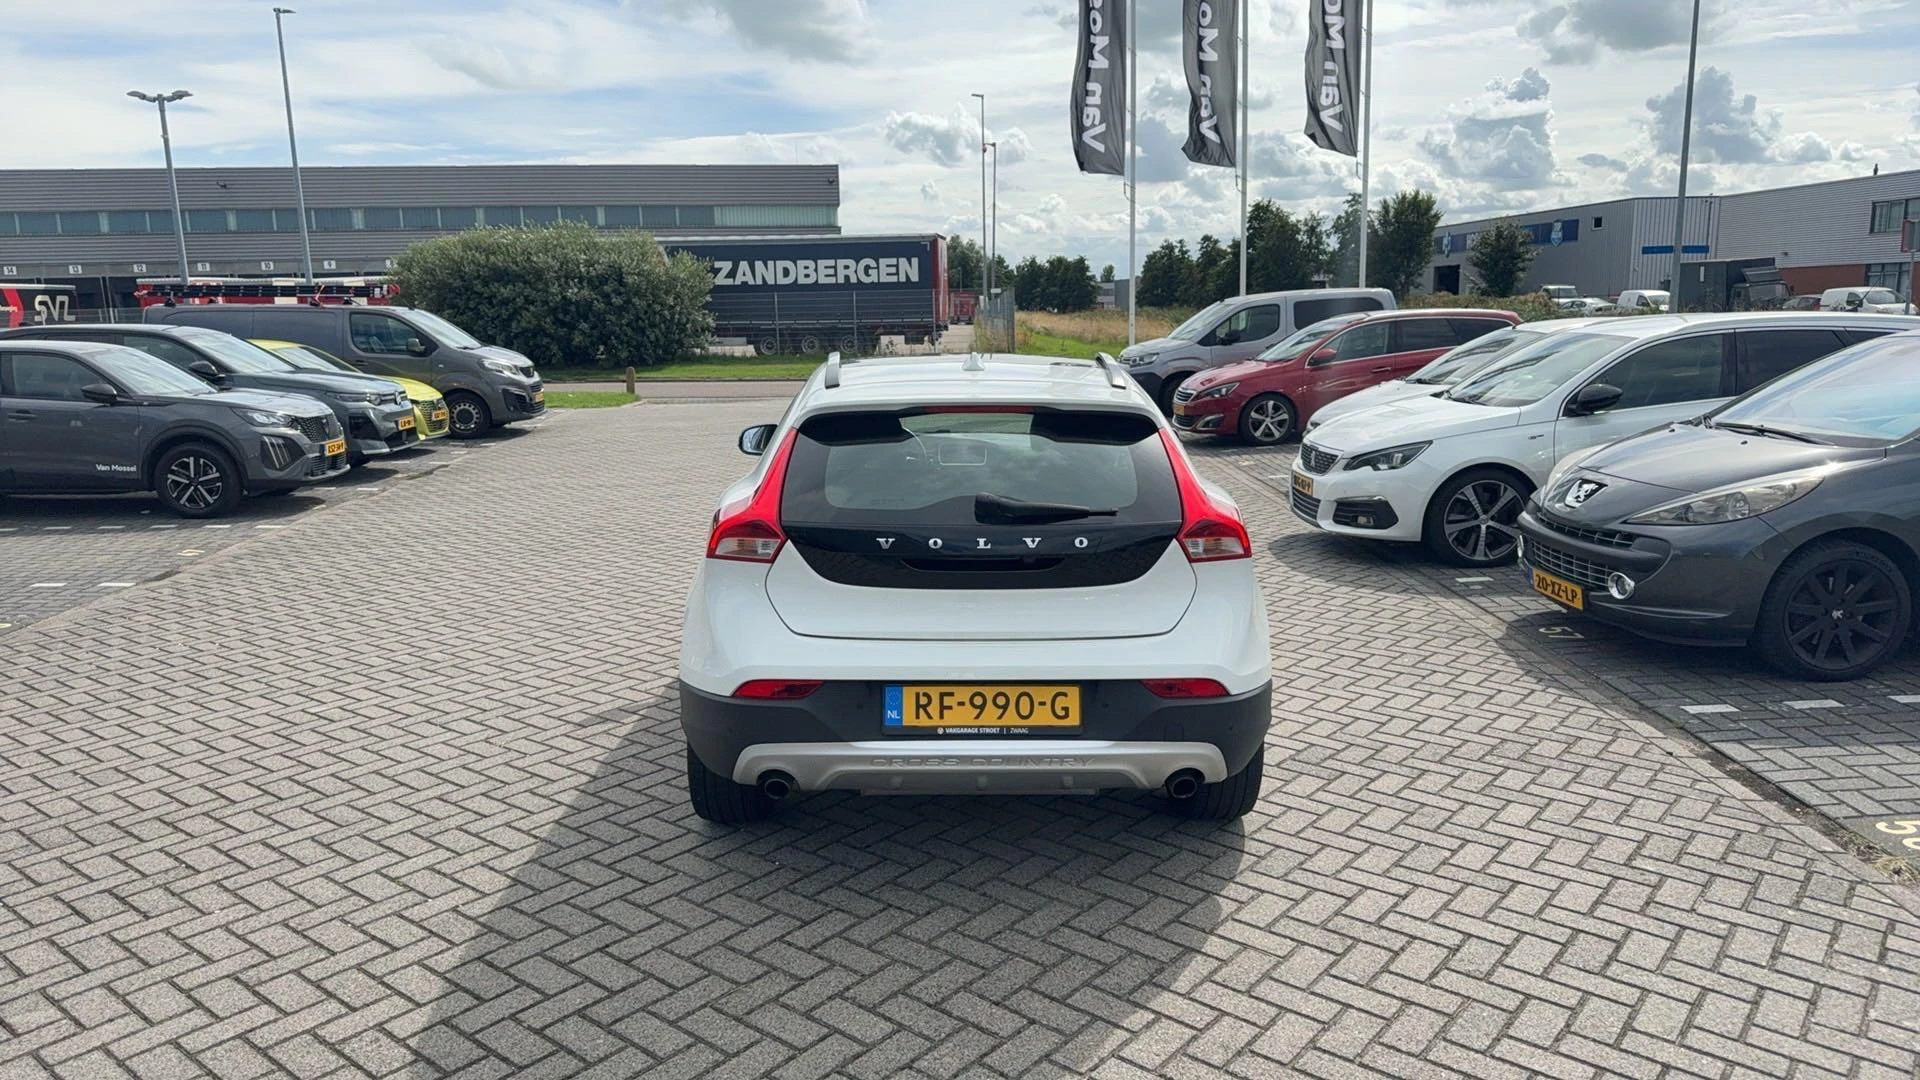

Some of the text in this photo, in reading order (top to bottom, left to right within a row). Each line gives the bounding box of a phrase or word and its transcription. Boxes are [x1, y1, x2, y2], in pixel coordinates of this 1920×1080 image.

[714, 257, 919, 285] ZANDBERGEN
[95, 463, 137, 472] Van Mossel
[876, 537, 1088, 550] VOLVO
[1535, 573, 1578, 603] 20-XZ-LP
[887, 691, 1070, 720] NL RF-990-G
[870, 758, 1096, 768] CROSS COUNTRY
